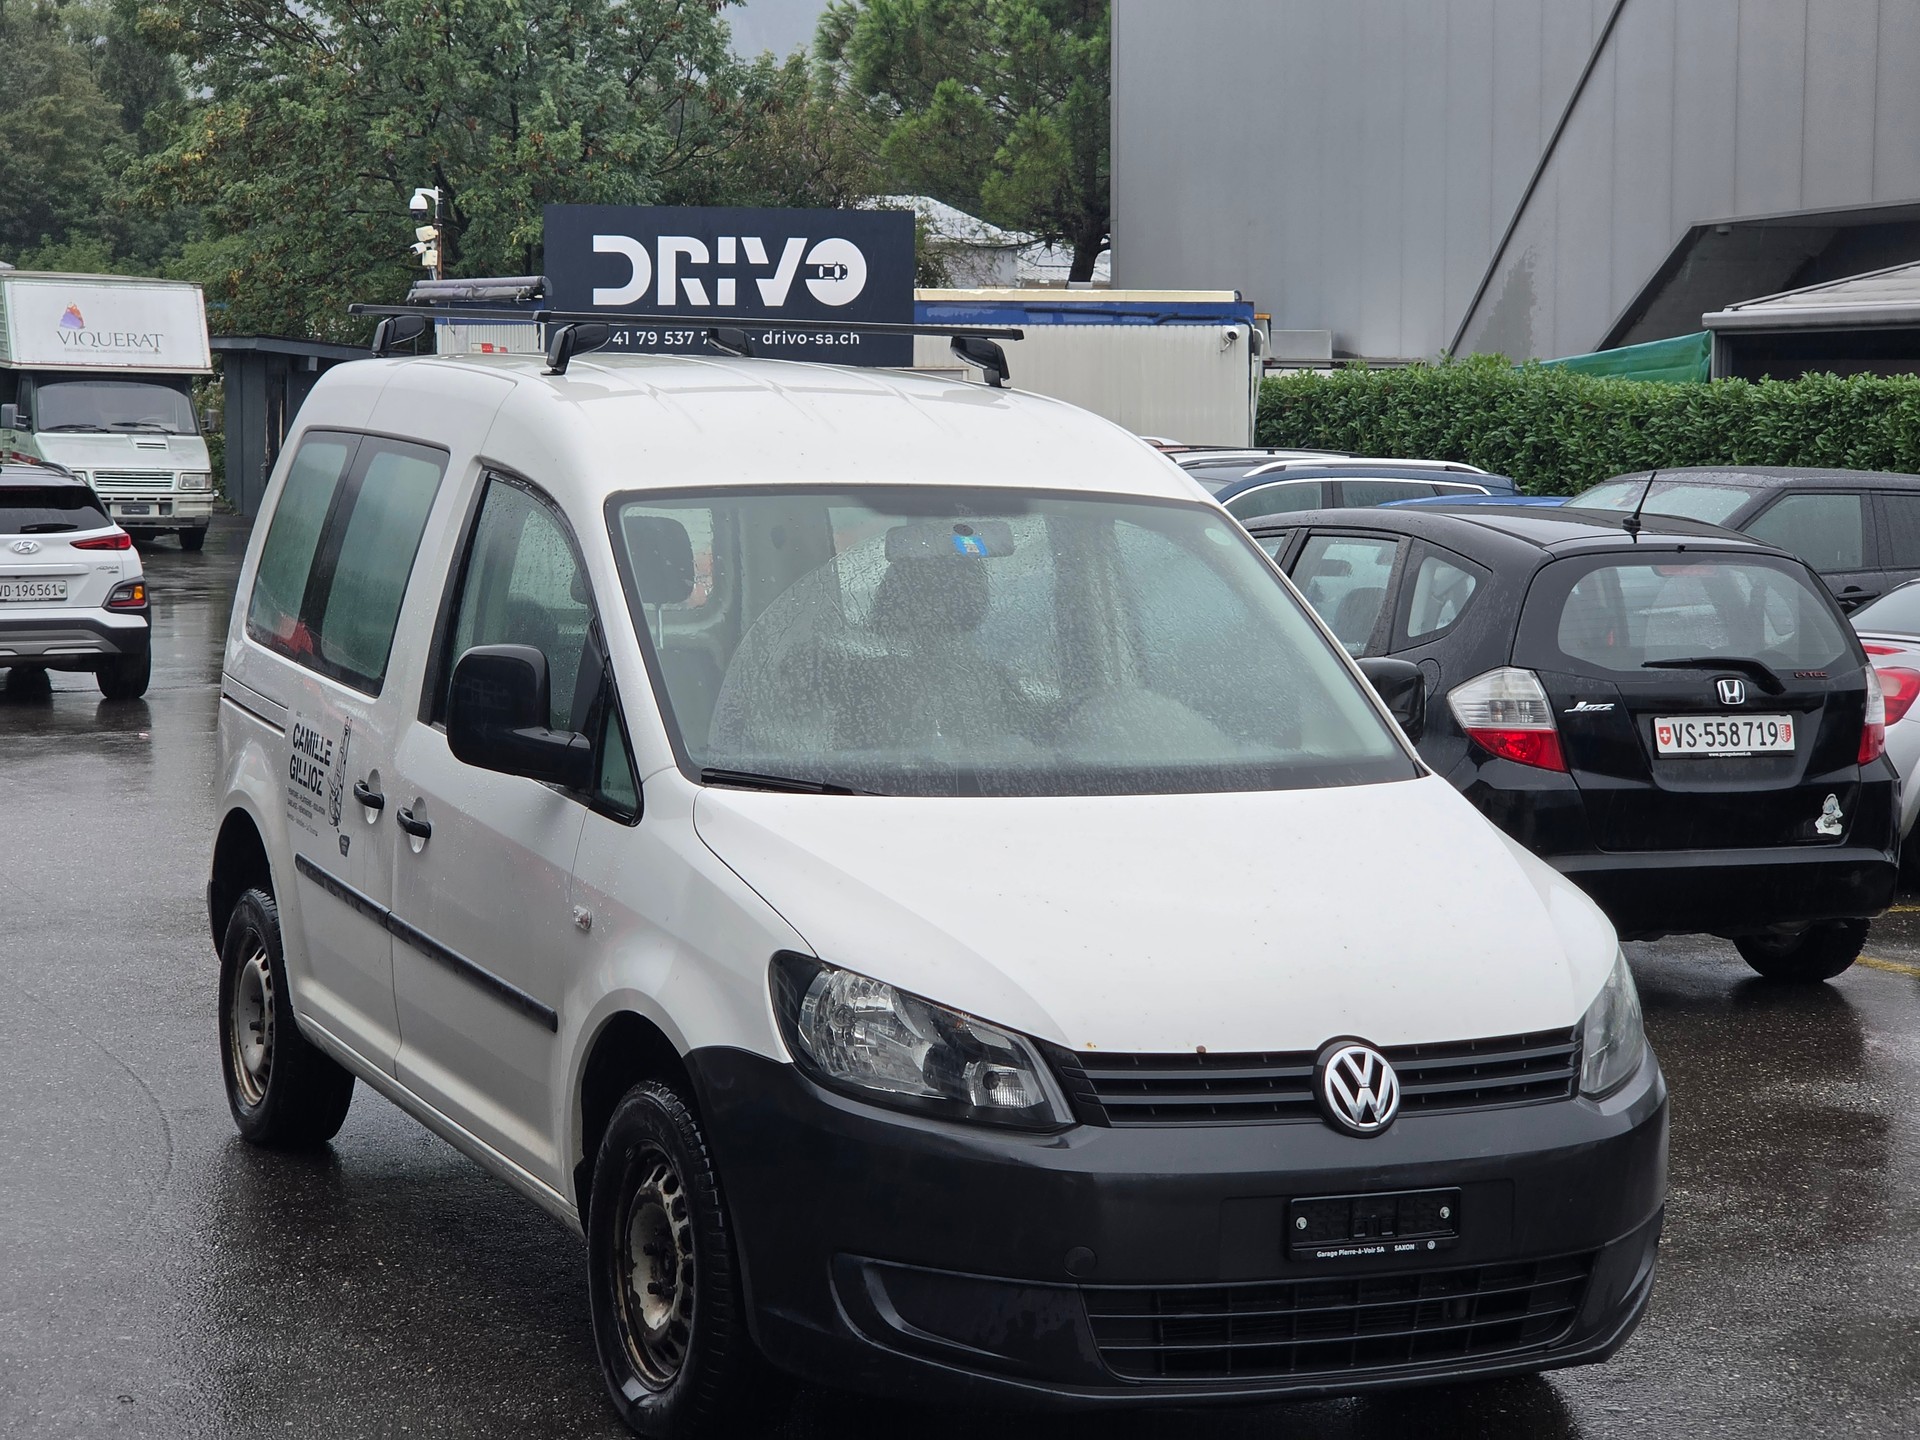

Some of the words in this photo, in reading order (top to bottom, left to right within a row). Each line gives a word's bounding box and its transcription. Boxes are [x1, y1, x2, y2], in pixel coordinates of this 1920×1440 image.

[592, 234, 867, 307] DRIVO
[56, 331, 164, 348] VIQUERAT
[636, 331, 658, 345] 79
[664, 331, 695, 345] 537
[762, 330, 860, 345] drivo-sa.ch
[1564, 701, 1615, 712] Jazz
[293, 722, 333, 767] CAMILLE
[289, 754, 325, 797] GILLIOZ
[1316, 1250, 1338, 1258] Garage
[1394, 1243, 1415, 1251] SAXON
